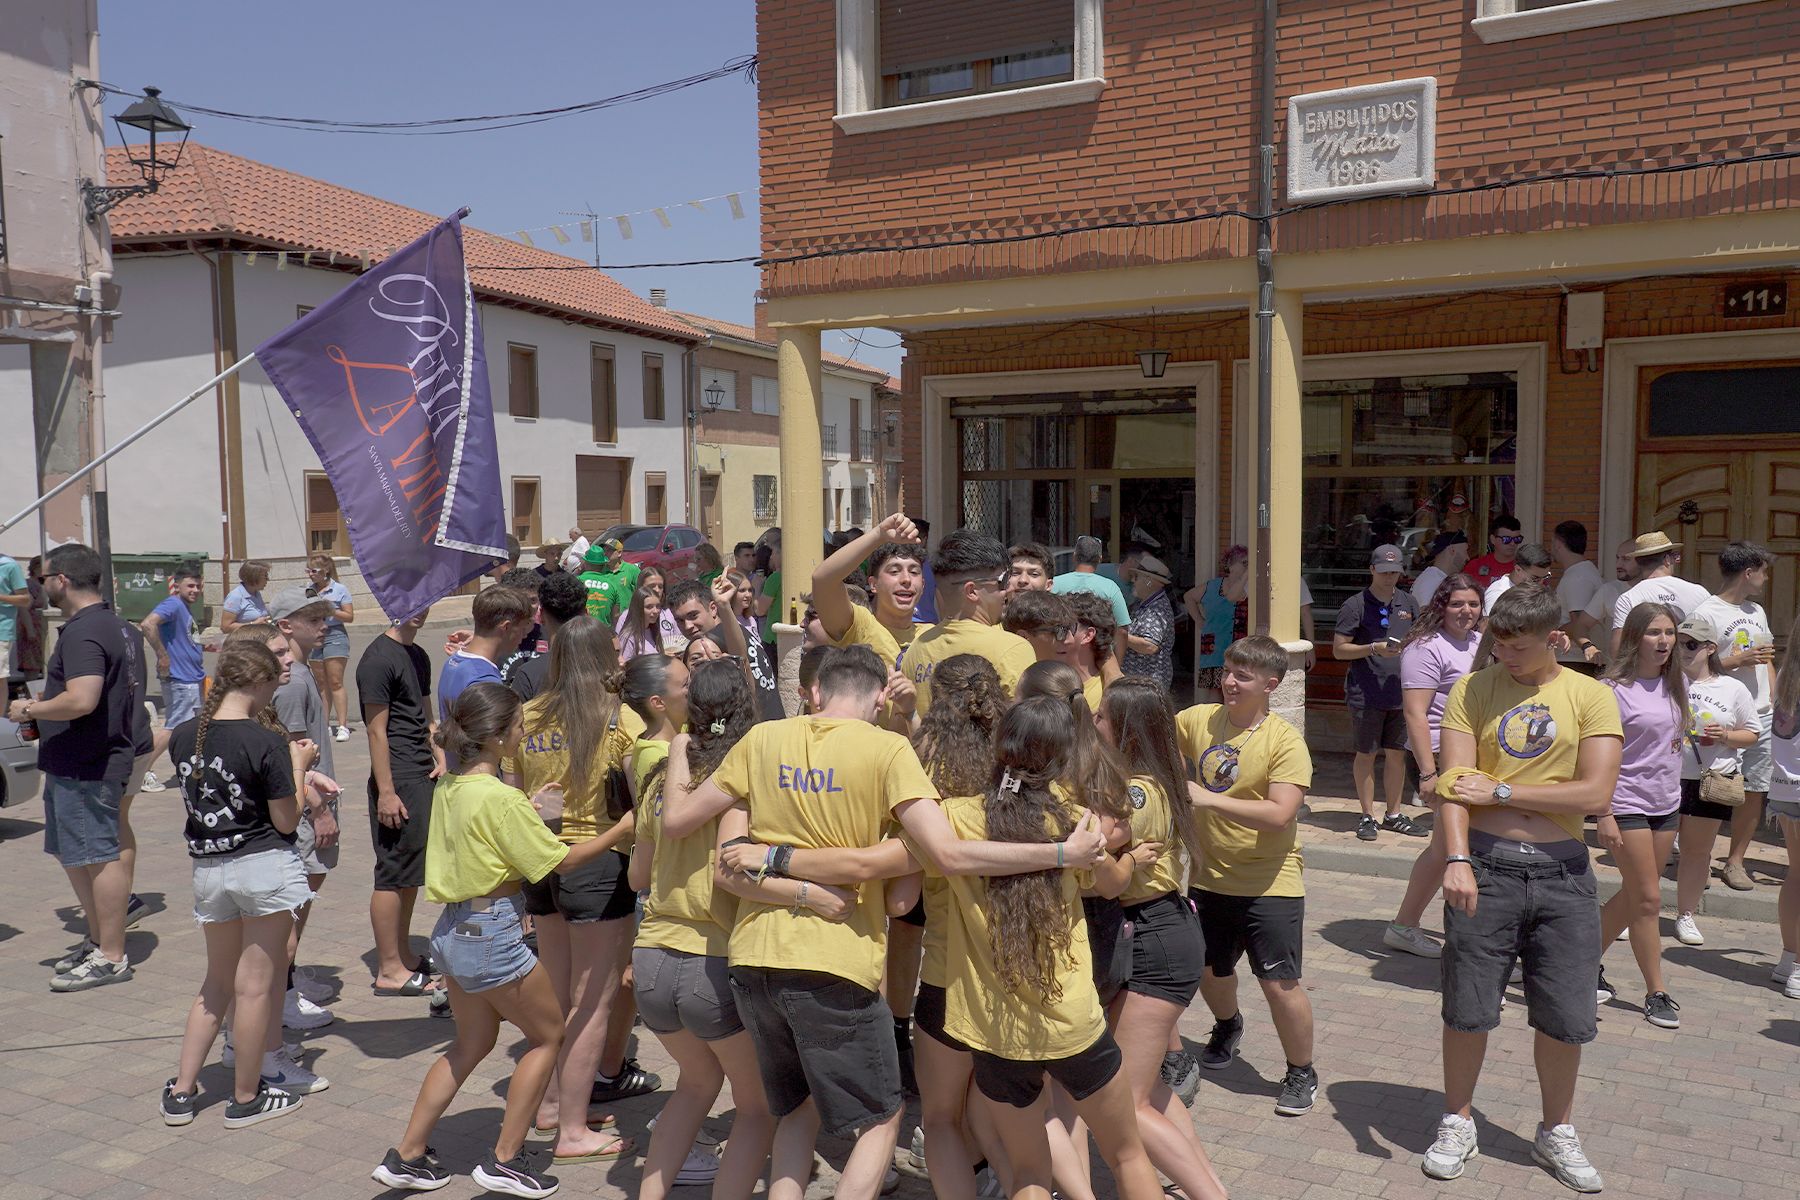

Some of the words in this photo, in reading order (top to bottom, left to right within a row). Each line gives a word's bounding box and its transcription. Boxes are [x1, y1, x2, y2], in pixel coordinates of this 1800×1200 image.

[1305, 100, 1418, 134] EMBUTIDOS
[1331, 159, 1381, 187] 1986
[1742, 289, 1769, 312] 11
[369, 273, 464, 444] PEÑA
[326, 345, 419, 437] LA
[368, 445, 383, 474] SANTA
[379, 472, 396, 507] MARINA
[392, 505, 405, 524] DEL
[400, 522, 413, 538] REY
[208, 755, 243, 811] AJOS
[778, 764, 844, 794] ENOL
